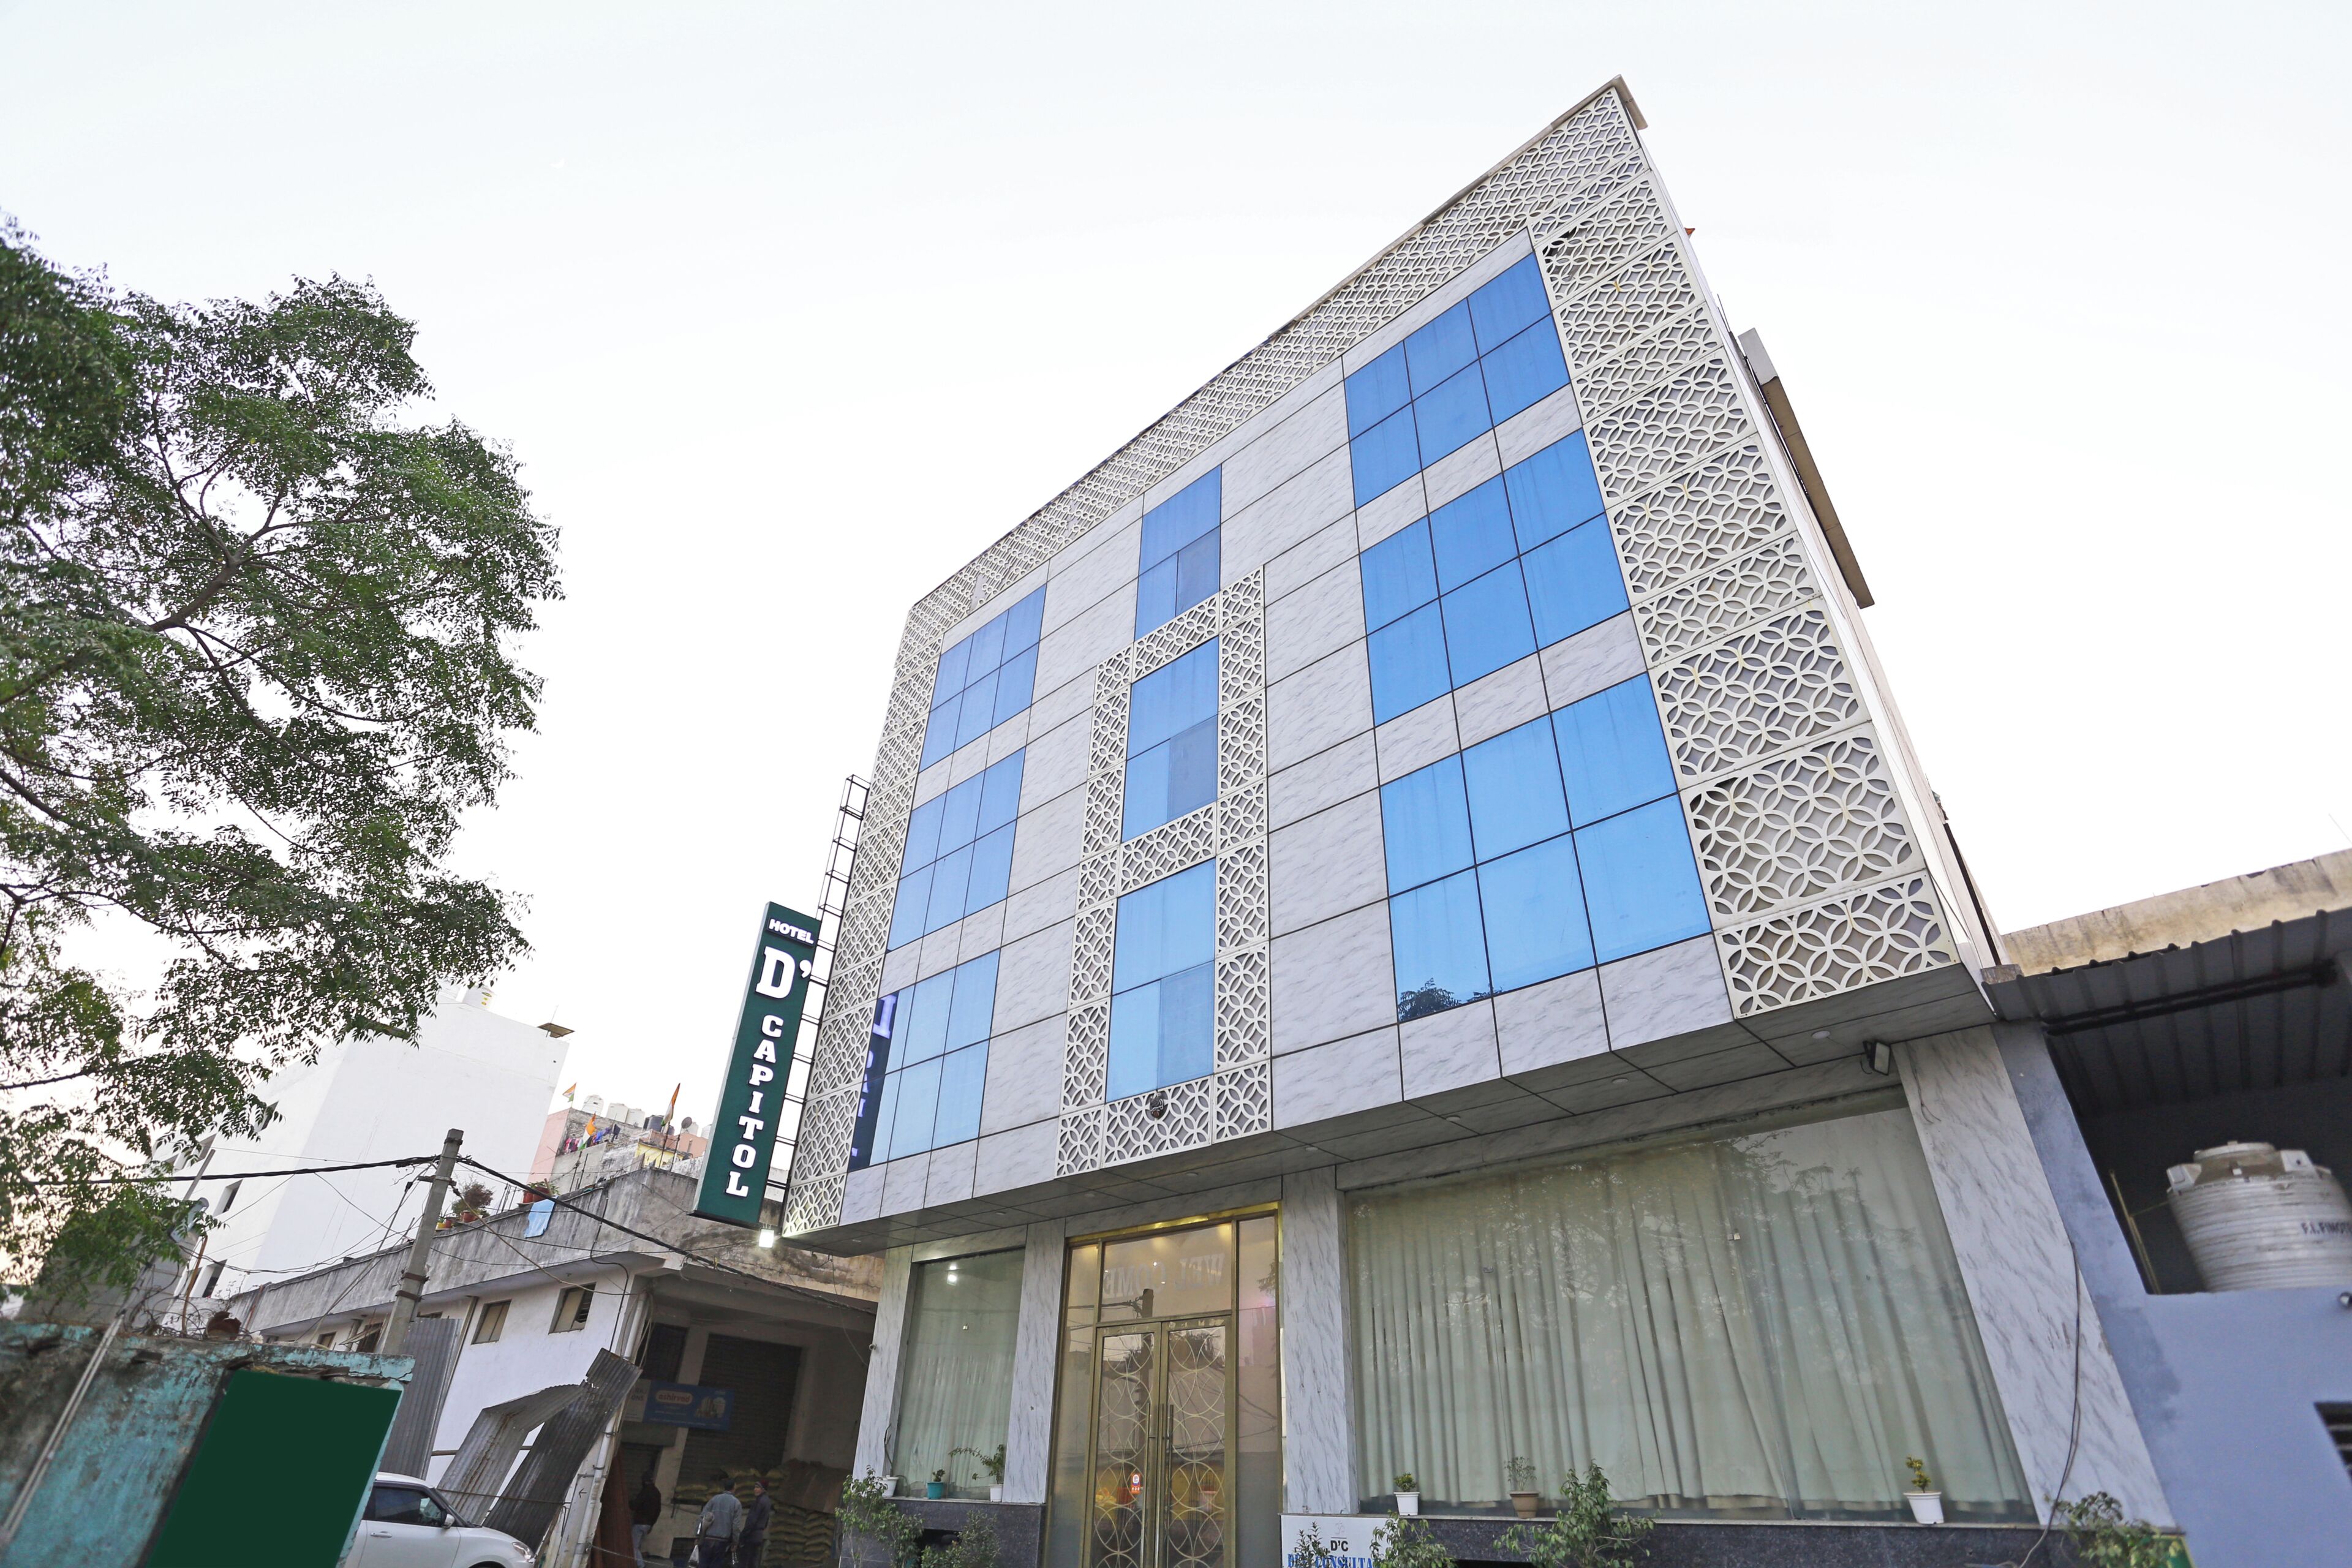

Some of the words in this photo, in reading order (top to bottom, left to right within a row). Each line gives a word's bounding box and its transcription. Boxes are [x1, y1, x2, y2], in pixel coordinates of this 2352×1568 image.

[768, 918, 814, 944] HOTEL
[726, 1014, 784, 1198] CAPITOL
[1330, 1540, 1349, 1552] D'C
